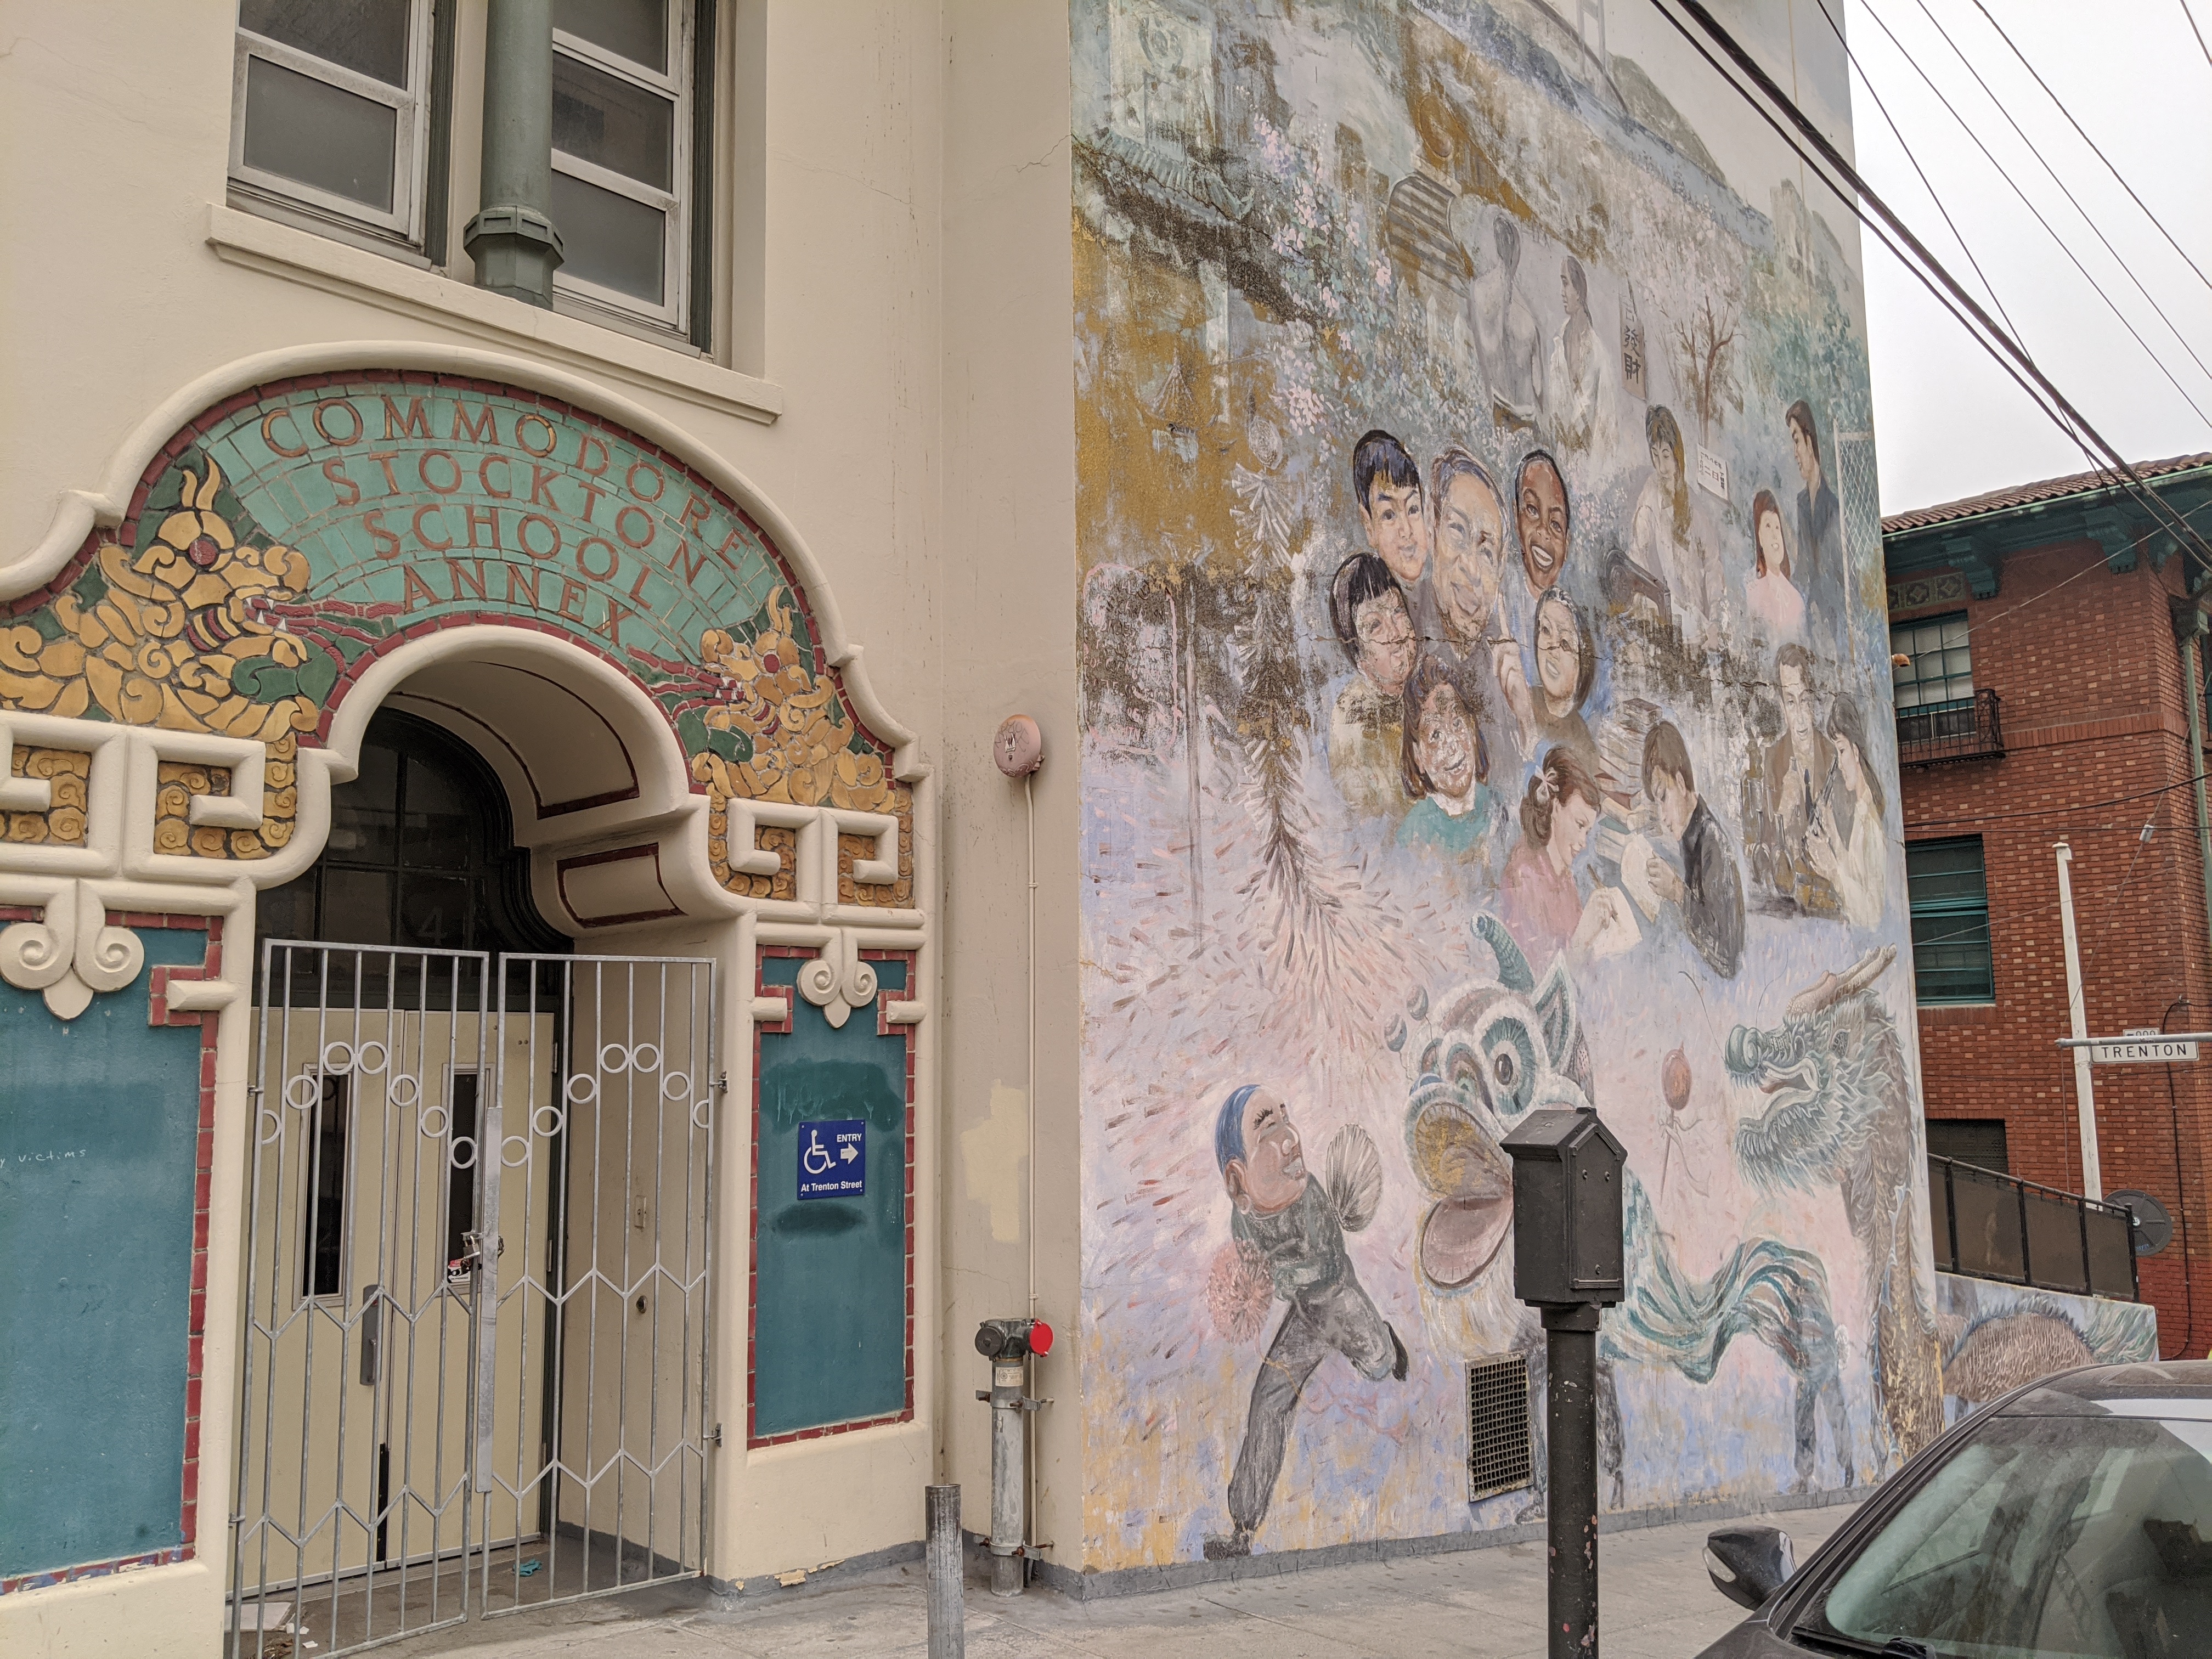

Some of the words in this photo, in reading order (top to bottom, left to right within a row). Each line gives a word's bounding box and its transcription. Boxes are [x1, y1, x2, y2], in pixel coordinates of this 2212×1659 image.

[261, 395, 751, 569] COMMODORE
[321, 448, 708, 589] STOCKTON
[363, 504, 653, 608] SCHOOL
[404, 557, 635, 648] ANNEX
[415, 907, 448, 945] 4
[2101, 1043, 2187, 1058] TRENTON
[18, 1149, 86, 1162] victims
[837, 1133, 862, 1142] ENTRY
[800, 1183, 809, 1192] At
[811, 1182, 839, 1191] Trenton
[840, 1180, 862, 1189] Street
